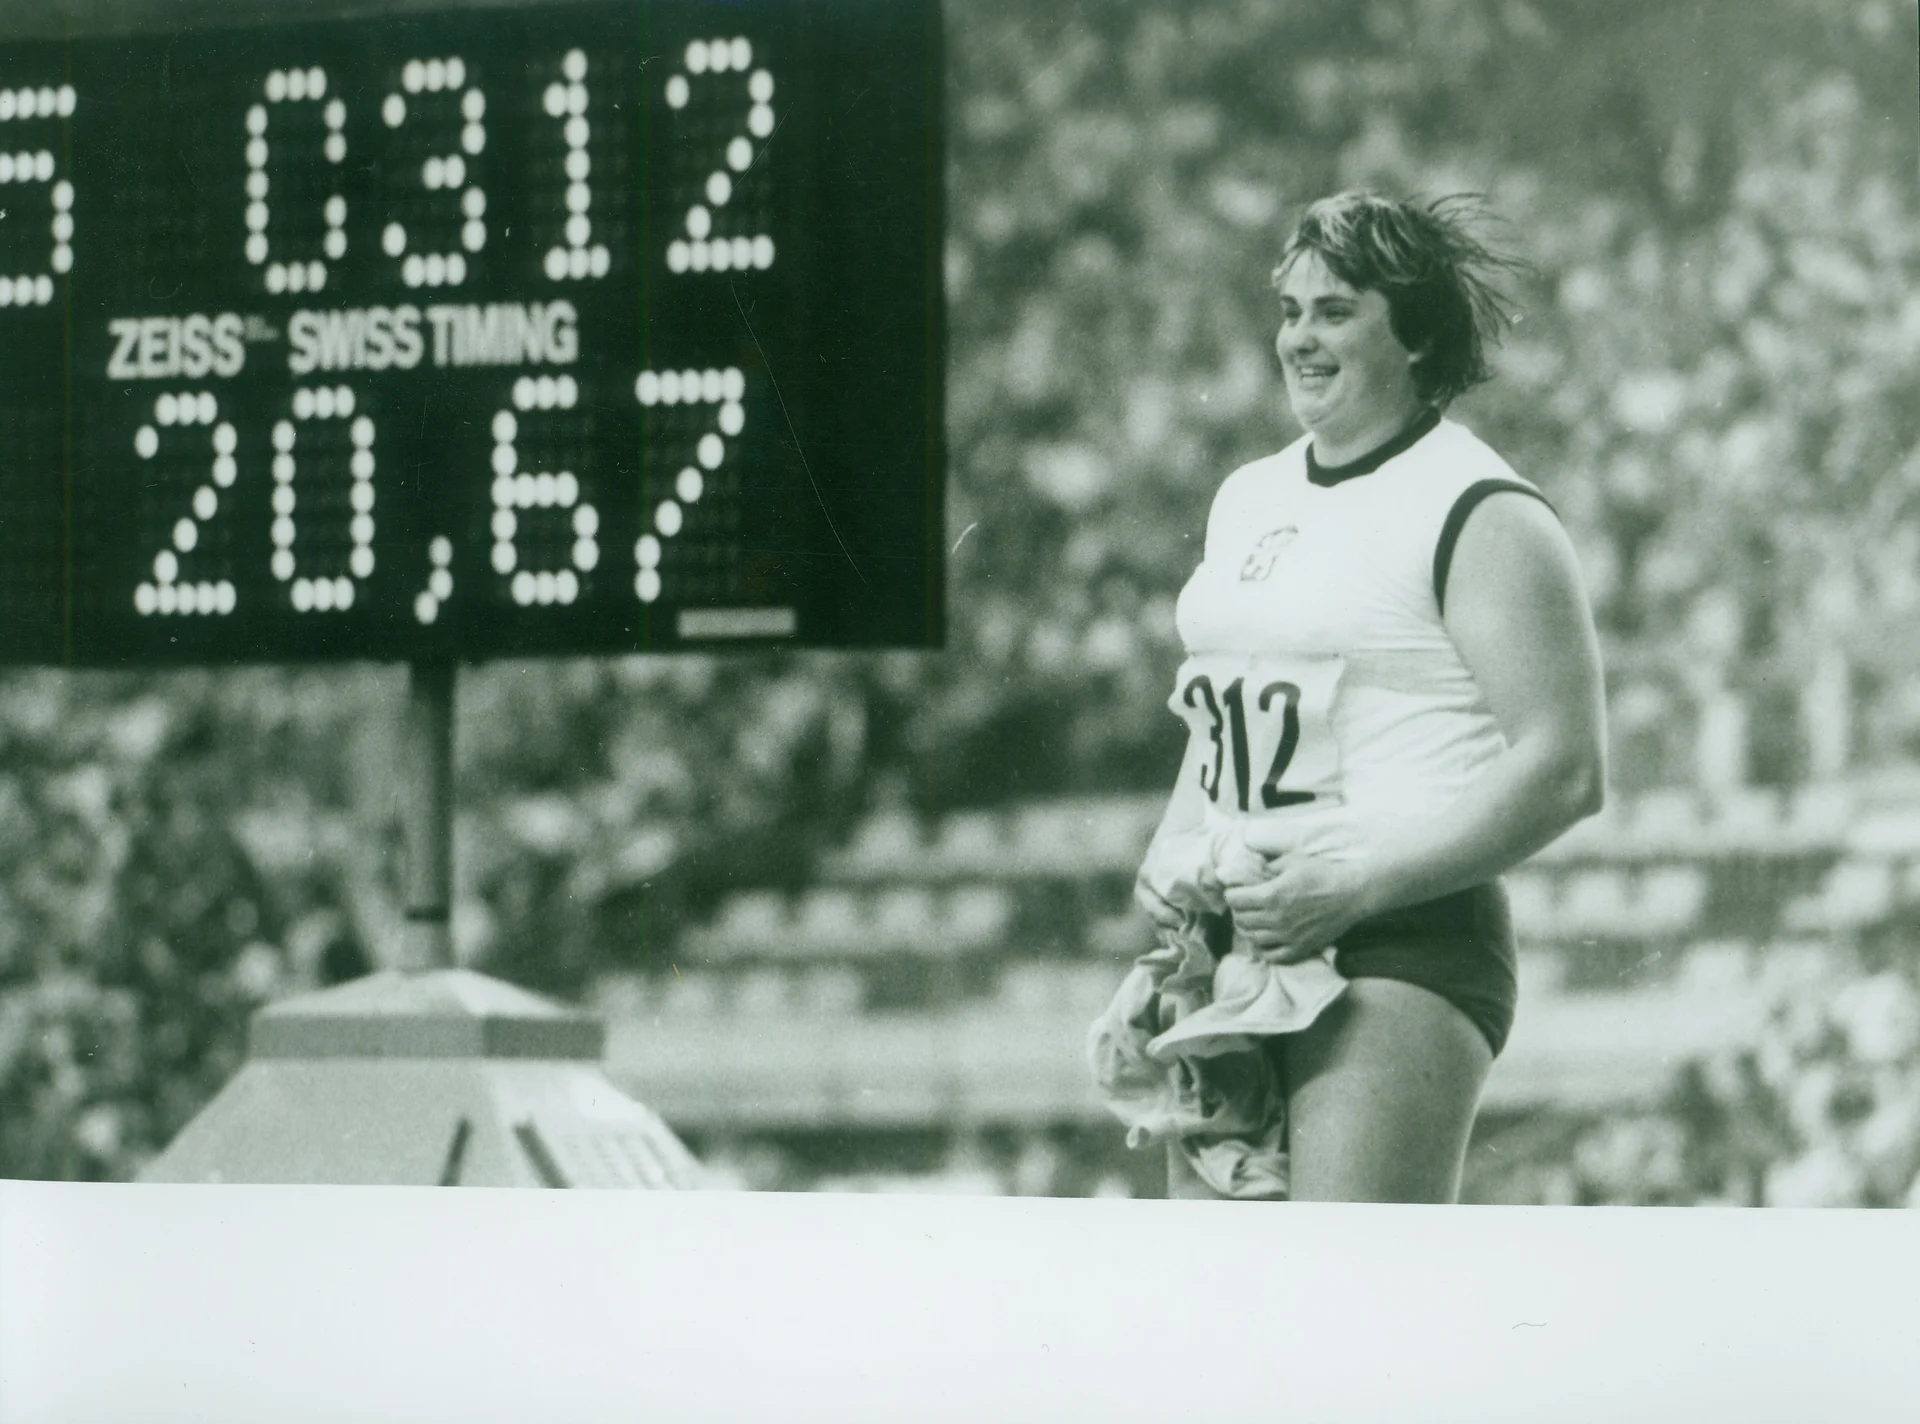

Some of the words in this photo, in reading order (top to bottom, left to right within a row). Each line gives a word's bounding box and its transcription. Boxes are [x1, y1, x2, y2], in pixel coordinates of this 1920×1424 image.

[246, 37, 776, 294] 0312
[107, 313, 246, 379] ZEISS
[288, 308, 424, 374] SWISS
[426, 301, 579, 368] TIMING
[134, 368, 745, 624] 20,67
[1183, 674, 1317, 812] 312
